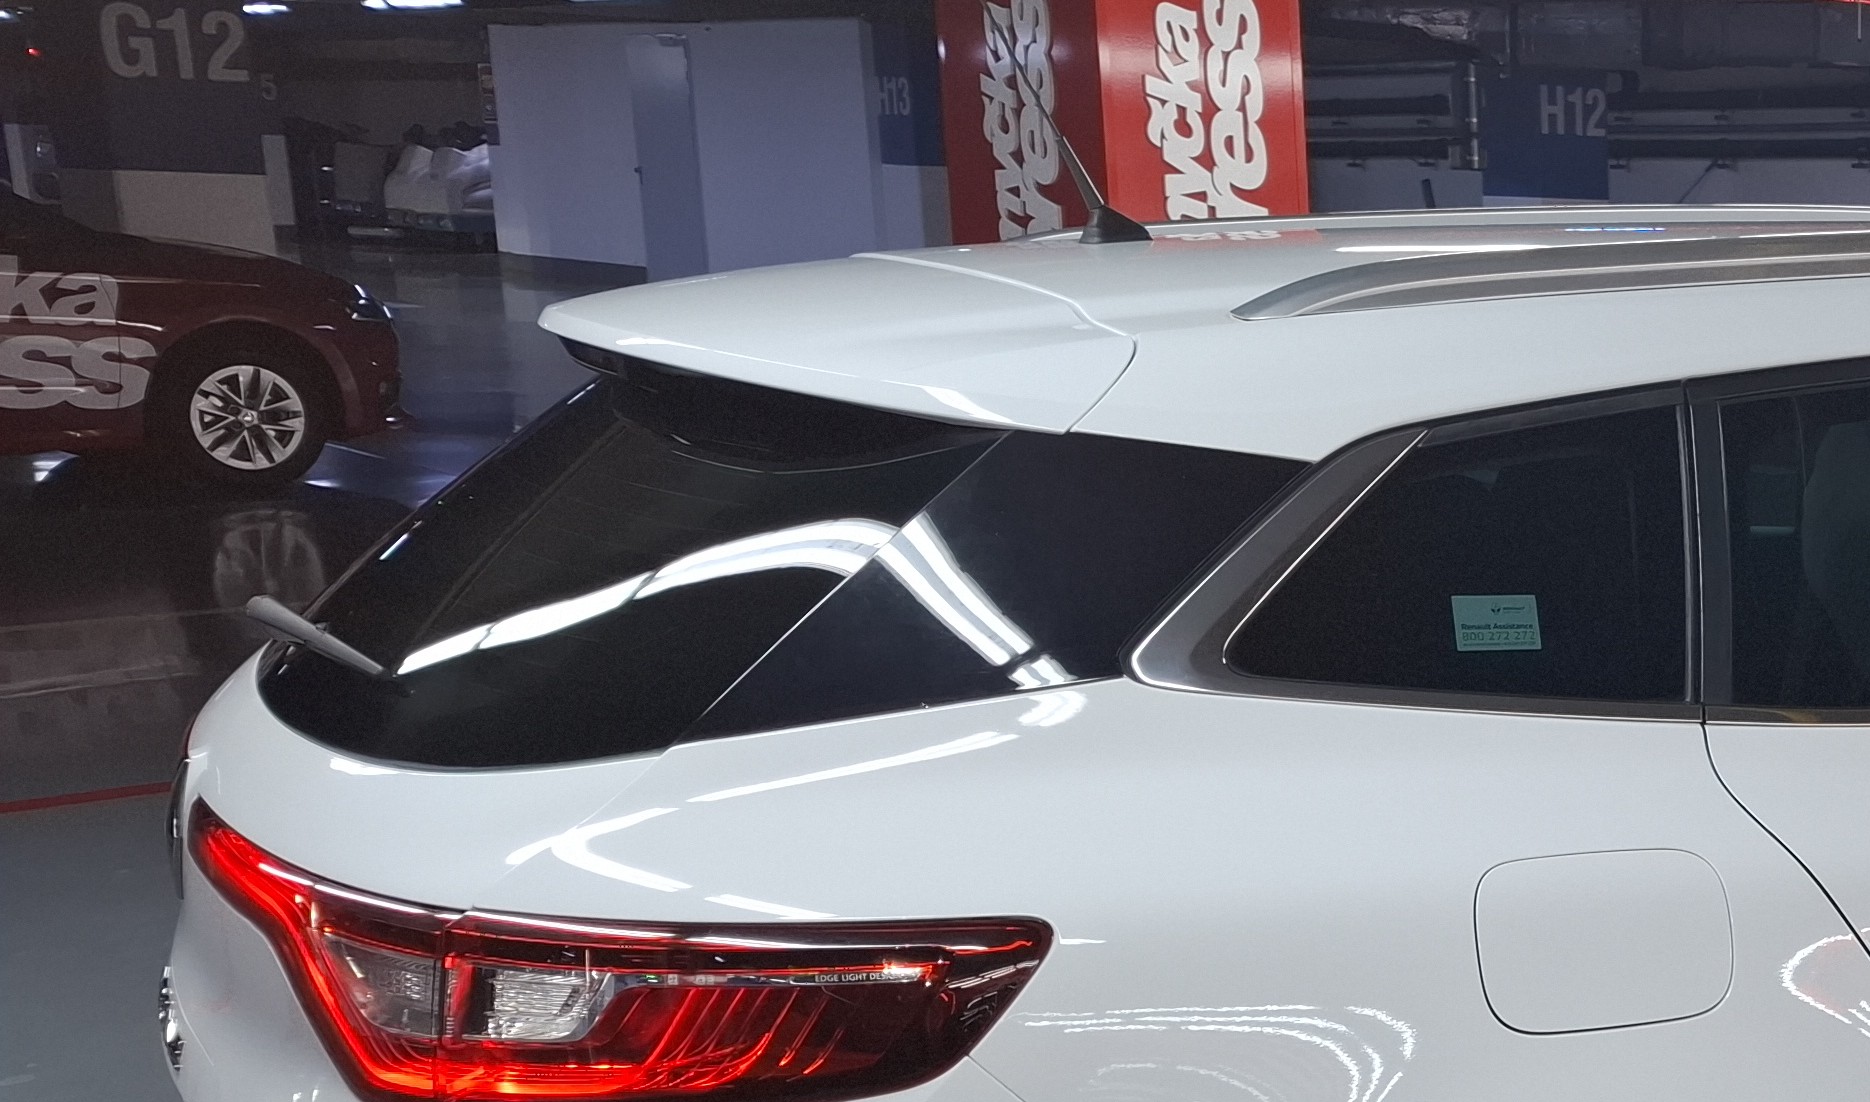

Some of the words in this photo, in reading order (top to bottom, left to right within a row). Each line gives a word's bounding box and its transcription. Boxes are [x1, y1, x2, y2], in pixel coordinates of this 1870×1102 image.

[99, 1, 250, 82] G12
[259, 74, 277, 100] 5
[1540, 85, 1606, 137] H12
[1462, 631, 1485, 641] 800
[1488, 631, 1510, 641] 272
[1514, 630, 1536, 640] 272
[814, 974, 839, 983] EDGE
[841, 973, 867, 982] LIGHT
